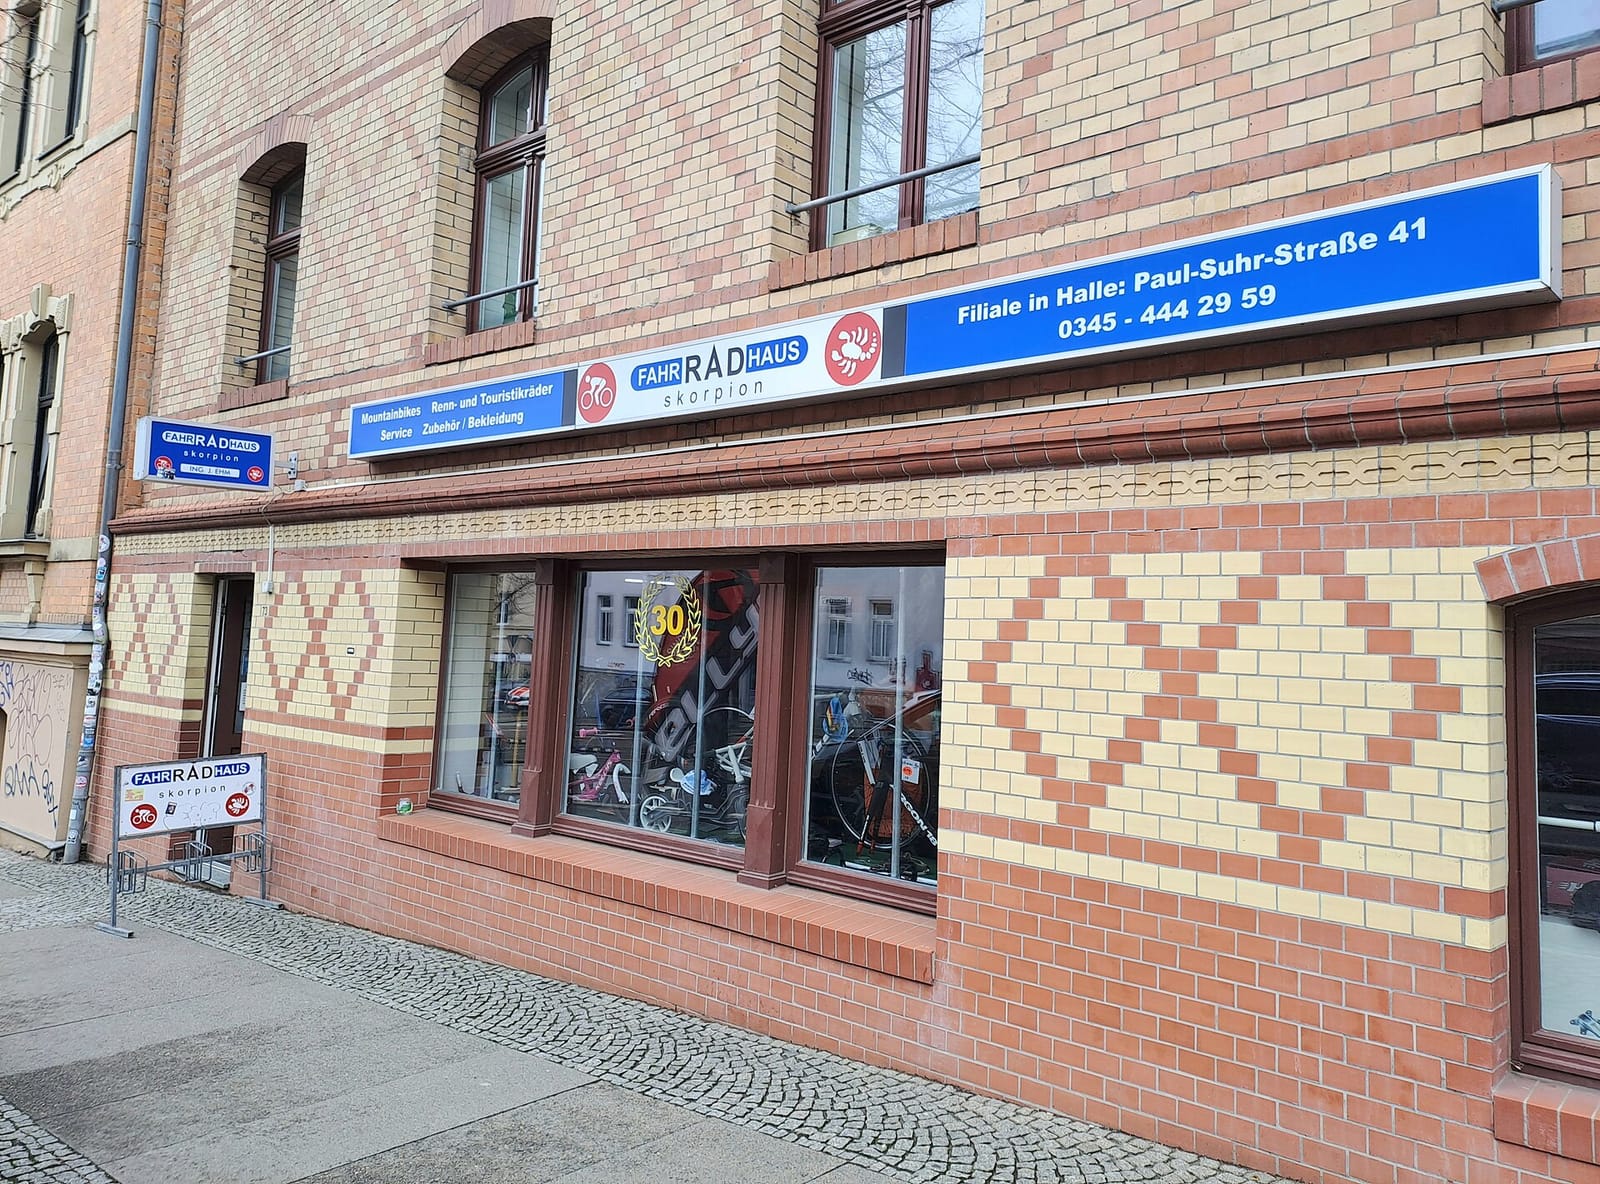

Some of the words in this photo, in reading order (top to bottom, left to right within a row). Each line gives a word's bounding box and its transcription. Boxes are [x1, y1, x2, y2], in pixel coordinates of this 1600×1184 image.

[957, 296, 1022, 325] Filiale
[1028, 292, 1049, 311] in
[1056, 278, 1126, 307] Halle:
[1133, 230, 1378, 292] Paul-Suhr-Straße
[1388, 216, 1427, 243] 41
[1058, 310, 1117, 339] 0345
[1140, 298, 1189, 327] 444
[1198, 292, 1232, 318] 29
[1240, 284, 1276, 311] 59
[638, 340, 800, 386] FAHRRADHAUS
[361, 405, 422, 425] Mountainbikes
[431, 401, 458, 414] Renn-
[460, 395, 478, 409] und
[480, 383, 554, 406] Touristikräder
[664, 378, 763, 408] skorpion
[165, 432, 258, 451] FAHRRADHAUS
[380, 427, 413, 442] Service
[422, 419, 461, 436] Zubehör
[468, 411, 524, 430] Bekleidung
[183, 450, 239, 462] skorpion
[650, 604, 684, 636] 30
[134, 764, 247, 785] FAHRRADHAUS
[158, 785, 226, 799] skorpion
